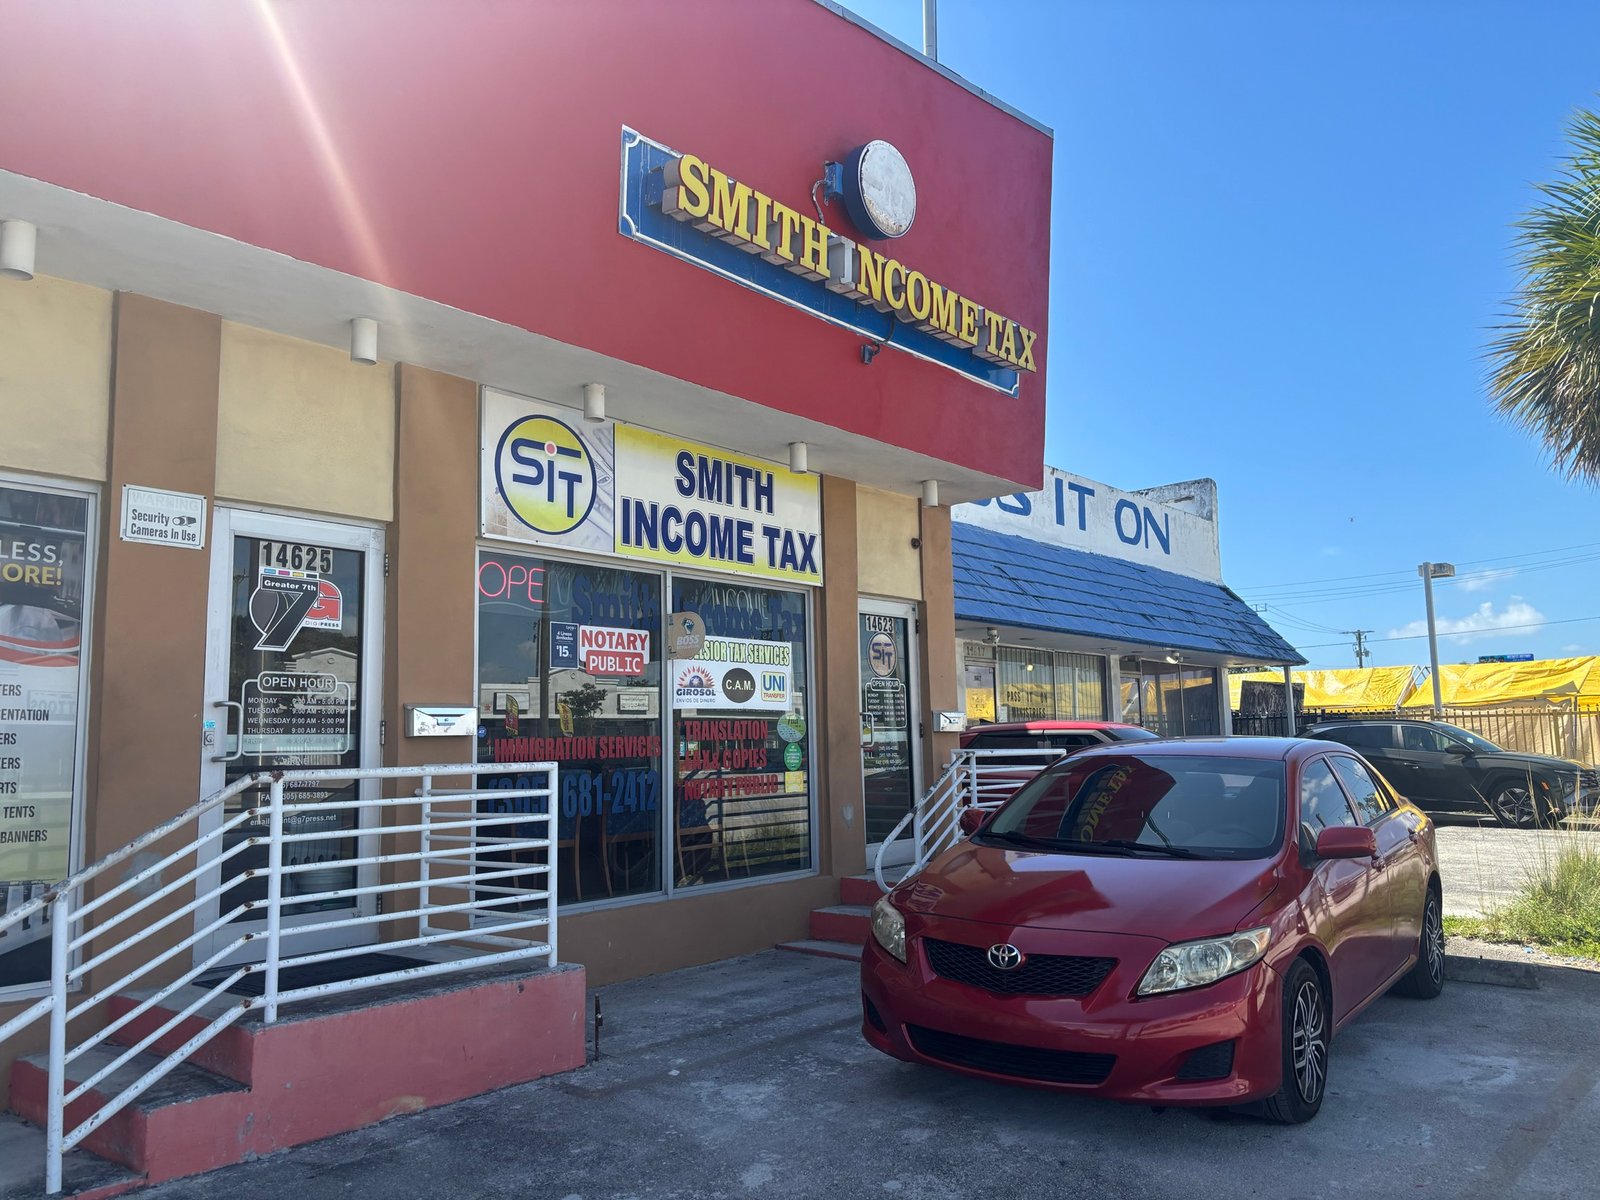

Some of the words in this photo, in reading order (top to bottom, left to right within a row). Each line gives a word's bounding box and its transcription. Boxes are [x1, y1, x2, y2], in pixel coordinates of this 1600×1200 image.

[678, 154, 830, 278] SMITH
[836, 236, 979, 346] INCOME
[984, 310, 1037, 372] TAX
[675, 450, 774, 515] SMITH
[132, 491, 199, 511] WARNING
[132, 508, 169, 526] Security
[1054, 477, 1095, 531] IT
[1115, 498, 1170, 555] ON
[131, 523, 168, 539] Cameras
[171, 528, 179, 540] In
[181, 529, 196, 542] Use
[621, 497, 755, 565] INCOME
[762, 525, 819, 575] TAX
[263, 542, 331, 573] 14625
[1, 563, 62, 586] ORE!
[264, 580, 299, 590] Greater
[302, 584, 317, 592] 7th
[867, 616, 893, 633] 14623
[581, 629, 648, 650] NOTARY
[677, 635, 700, 645] BOSS
[728, 641, 747, 663] TAX
[748, 643, 790, 666] SERVICES
[589, 655, 641, 672] PUBLIC
[263, 677, 296, 688] OPEN
[300, 678, 333, 689] HOUR
[726, 679, 753, 691] C.A.M.
[763, 675, 784, 691] UNI
[676, 688, 716, 697] GIROSOL
[1007, 691, 1020, 702] PASS
[1026, 692, 1032, 703] IT
[0, 708, 49, 721] ENTATION
[1012, 707, 1046, 718] MINISTRIES
[684, 720, 768, 740] TRANSLATION
[494, 736, 597, 762] IMMIGRATION
[599, 735, 661, 759] SERVICES
[0, 757, 21, 769] ERS
[722, 748, 767, 769] COPIES
[487, 773, 547, 815] (305
[562, 768, 658, 818] 681-2412
[684, 776, 734, 800] NOTARY
[735, 774, 778, 796] PUBLIC
[282, 793, 297, 801] 305)
[298, 792, 328, 800] 685-3893
[3, 806, 35, 819] TENTS
[250, 818, 270, 826] email
[282, 814, 336, 825] int@g7press.net
[0, 829, 48, 843] BANNERS
